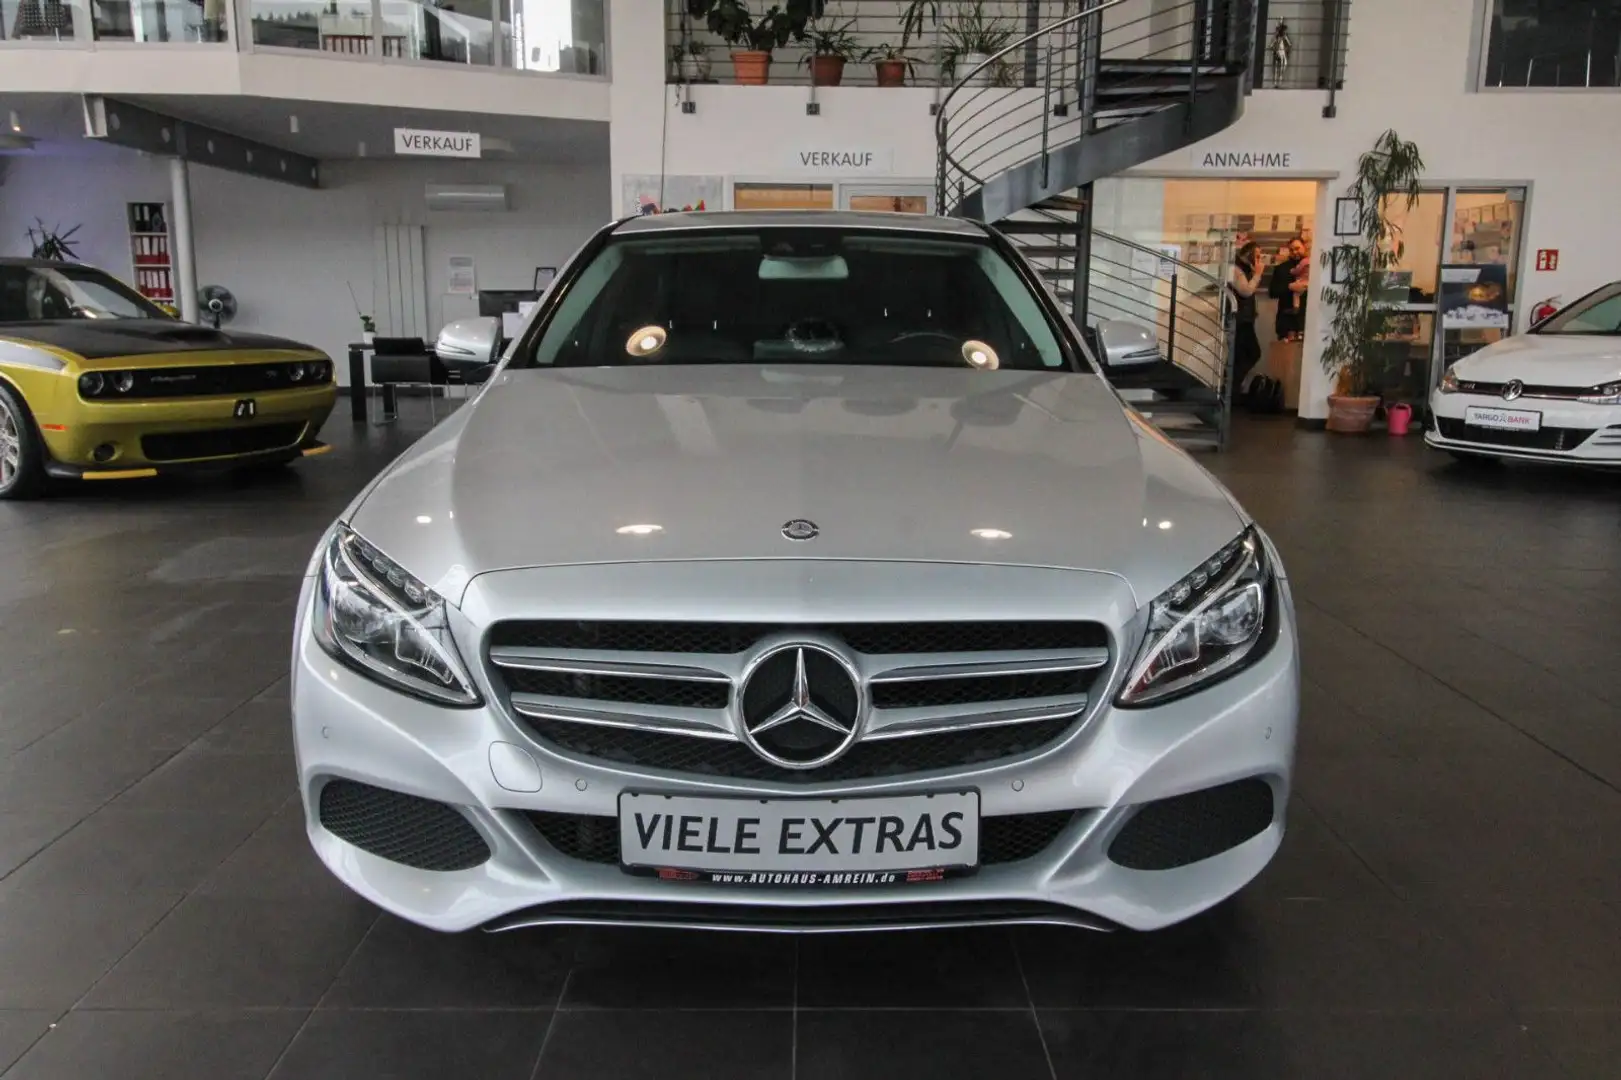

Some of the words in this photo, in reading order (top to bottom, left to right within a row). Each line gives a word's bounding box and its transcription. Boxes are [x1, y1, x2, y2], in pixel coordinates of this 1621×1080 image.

[401, 133, 473, 152] VERKAUF
[800, 151, 873, 167] VERKAUF
[1202, 152, 1291, 168] ANNAHME
[1473, 412, 1499, 423] TARGO
[1507, 415, 1532, 425] BANK
[634, 812, 761, 855] VIELE
[778, 811, 965, 855] EXTRAS
[711, 870, 896, 885] www.AUTOHAUS-AMREIN.de
